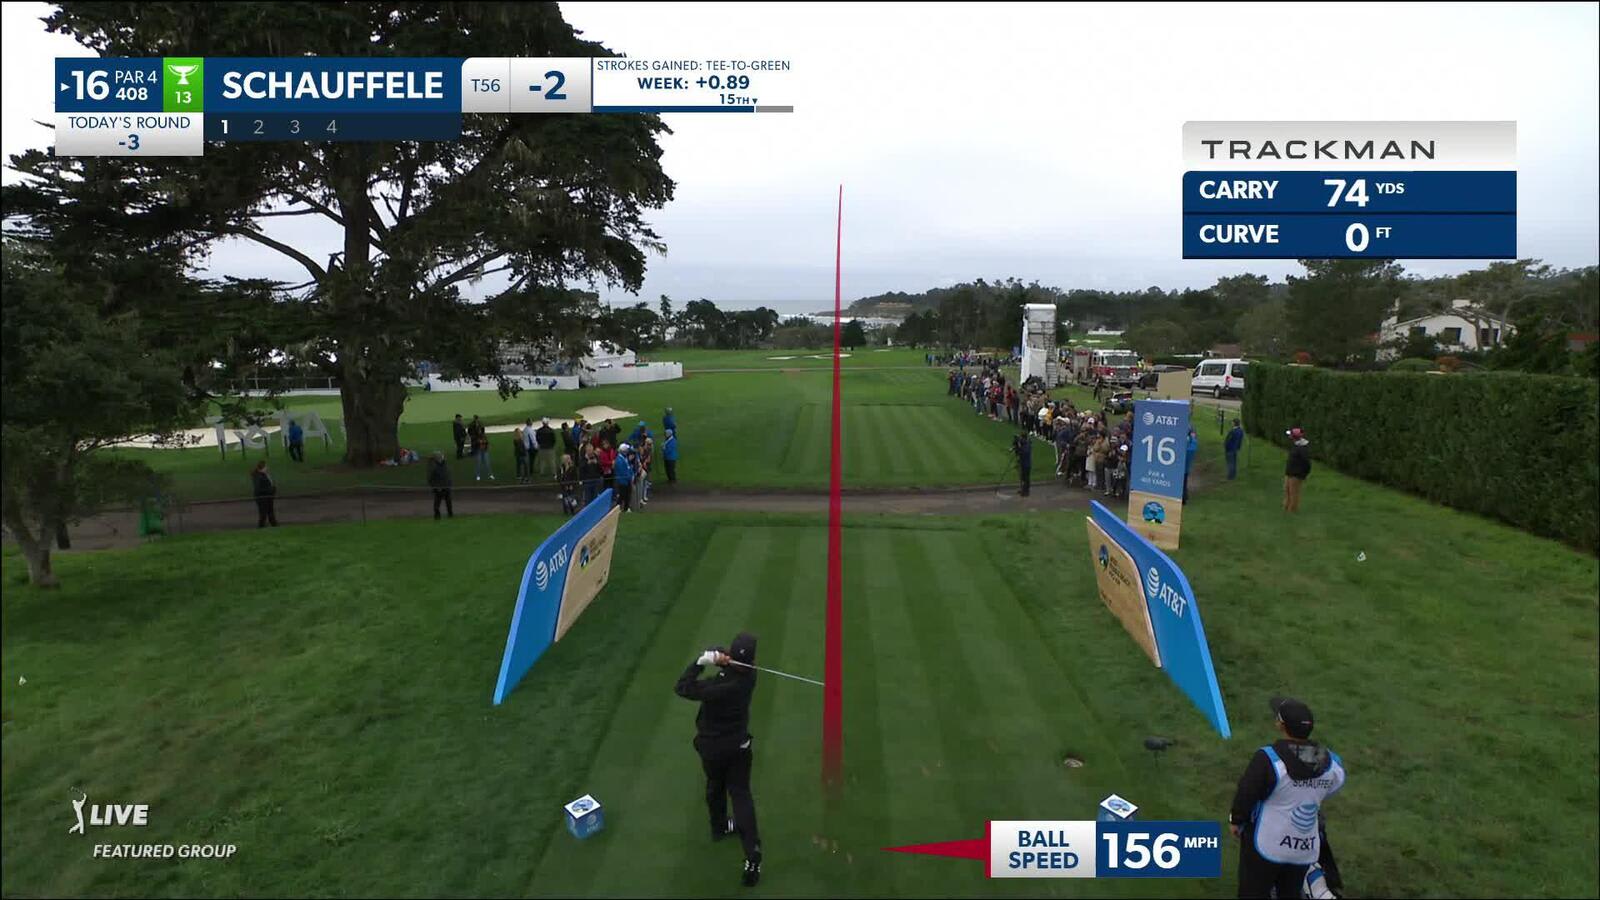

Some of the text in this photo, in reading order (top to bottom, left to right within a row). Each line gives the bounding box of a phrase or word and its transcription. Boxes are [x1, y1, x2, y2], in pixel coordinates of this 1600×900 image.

[1155, 415, 1180, 426] AT&T
[1141, 434, 1176, 466] 16
[549, 544, 568, 577] AT&T
[1159, 583, 1187, 619] AT&T
[1280, 835, 1316, 851] AT&T
